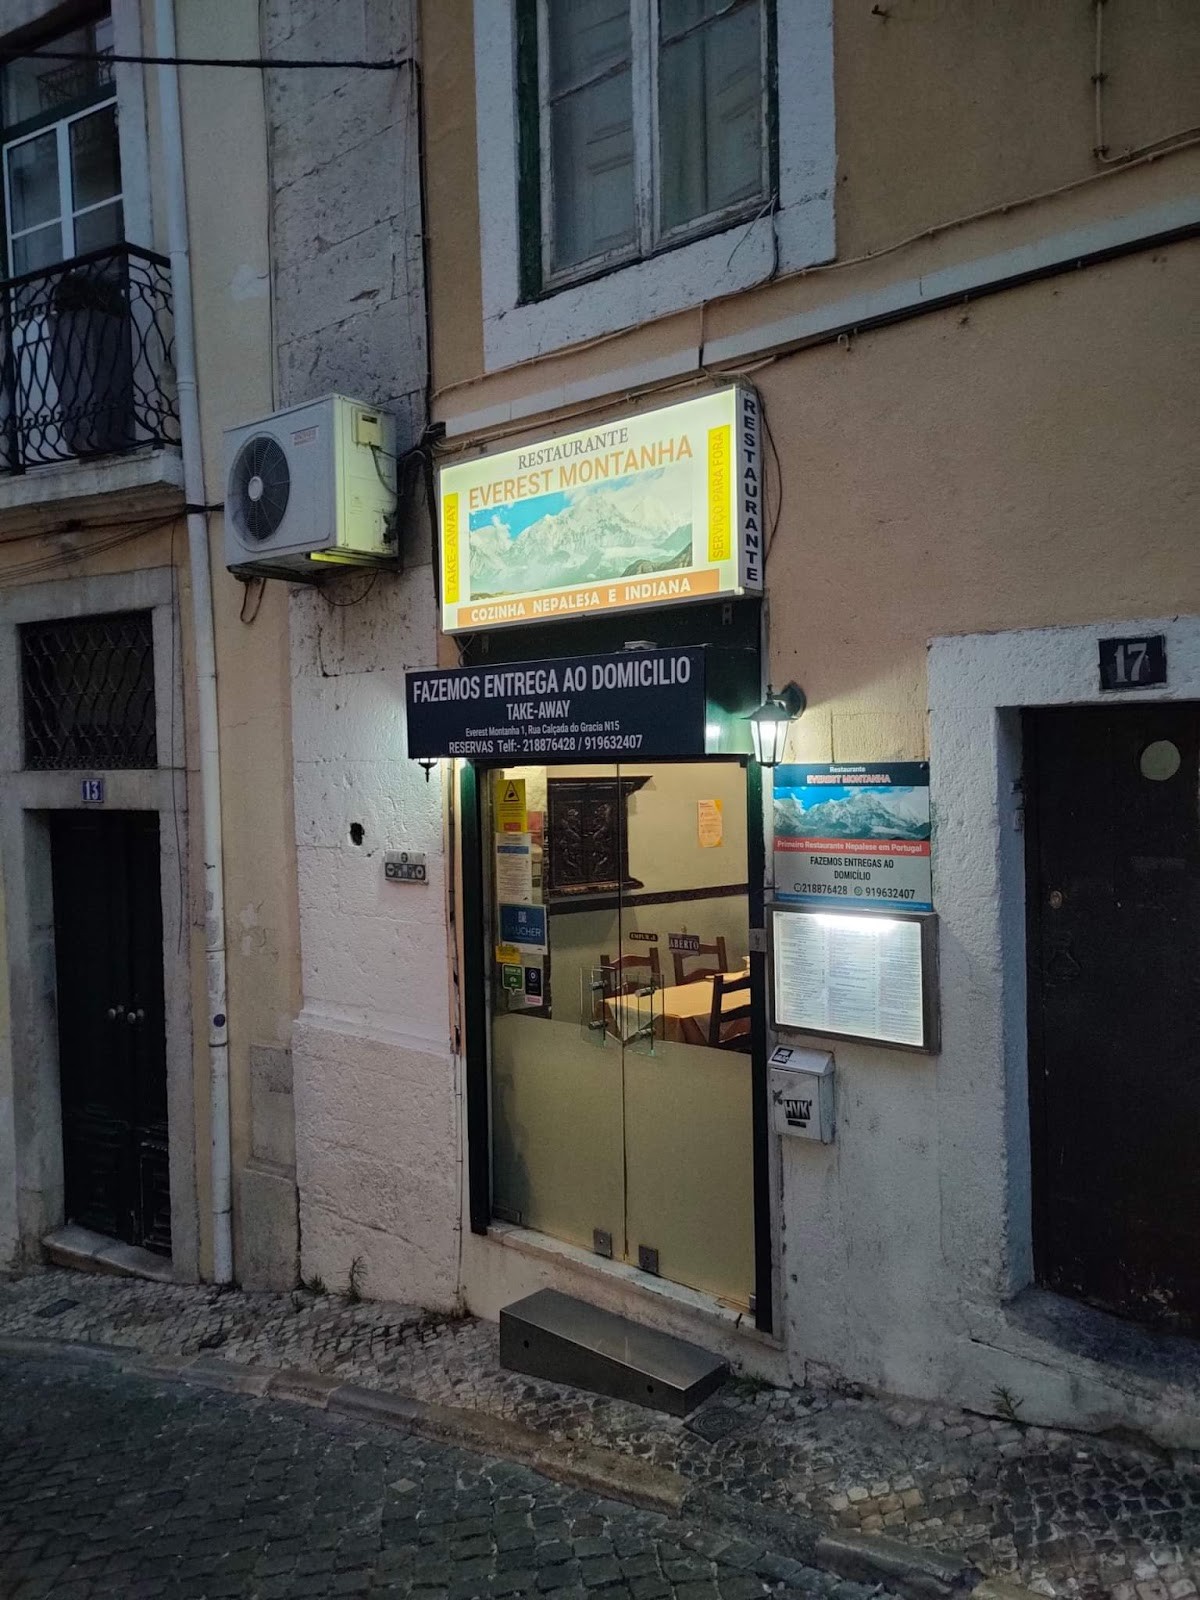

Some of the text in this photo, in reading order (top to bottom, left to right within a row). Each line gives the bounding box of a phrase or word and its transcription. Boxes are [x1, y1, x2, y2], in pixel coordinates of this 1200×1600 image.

[518, 427, 629, 470] RESTAURANTE
[469, 434, 693, 510] EVEREST MONTANHA
[711, 431, 726, 559] SERVIÇO PARA FORA
[744, 398, 758, 582] RESTAURANTE
[446, 504, 457, 595] TAKE-AWAY
[471, 577, 691, 623] COZINHA NEPALESA E INDIANA
[1114, 643, 1147, 682] 17
[413, 656, 690, 703] FAZEMOS ENTREGA AO DOMICILIO
[506, 700, 570, 720] TAKE-AWAY
[465, 727, 488, 737] Everest
[489, 725, 519, 736] Montanha
[528, 724, 541, 734] Rua
[542, 722, 569, 735] Calçada
[570, 722, 579, 733] do
[580, 720, 603, 732] Gracia
[604, 720, 620, 731] N15
[449, 740, 494, 754] RESERVAS
[523, 737, 576, 752] 218876428
[577, 737, 582, 751] /
[585, 734, 643, 750] 919632407
[86, 781, 99, 800] 13
[777, 841, 804, 849] Primeiro
[805, 842, 845, 851] Restaurante
[845, 842, 878, 852] Nepalese
[891, 844, 922, 854] Portugal
[810, 856, 894, 868] FAZEMOS ENTREGAS AO
[834, 869, 871, 880] DOMICÍLIO
[802, 883, 915, 899] 218876428 919632407
[670, 938, 699, 951] ABERTO
